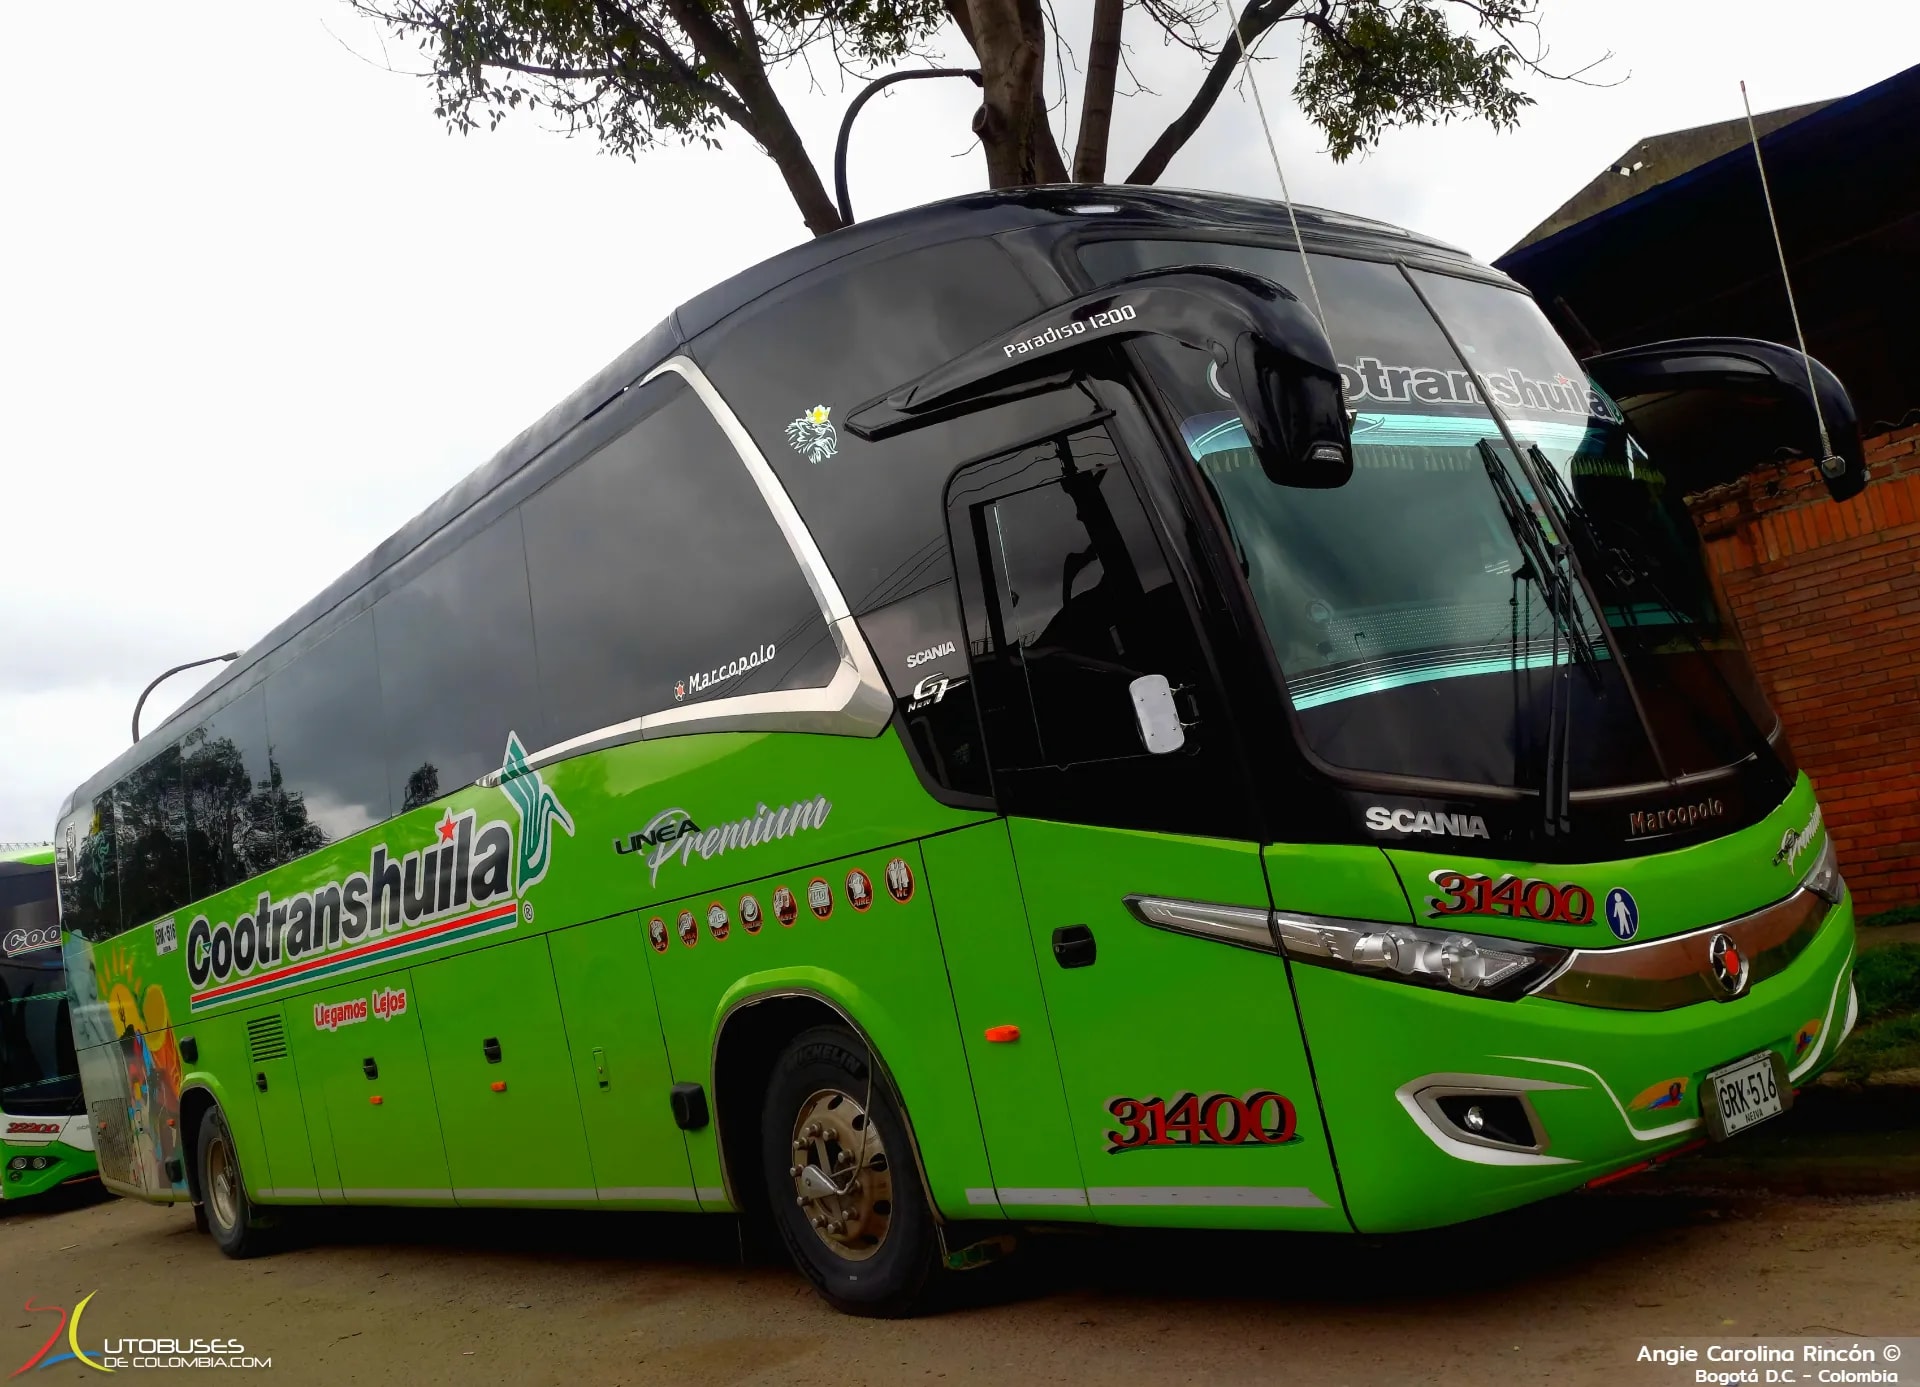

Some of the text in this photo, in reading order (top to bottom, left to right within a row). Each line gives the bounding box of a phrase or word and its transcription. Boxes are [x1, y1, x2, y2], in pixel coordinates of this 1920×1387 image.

[1003, 304, 1137, 358] Paradiso 1200
[1207, 356, 1616, 422] otranshuila
[688, 643, 776, 695] Marcopolo
[906, 640, 956, 668] SCANIA
[615, 794, 833, 888] LINEA Premium
[1365, 806, 1490, 840] SCANIA
[1630, 798, 1724, 835] Marcopolo
[187, 808, 512, 988] Cootranshuila
[1425, 868, 1598, 926] 31400
[372, 987, 407, 1021] Lejos
[1103, 1087, 1303, 1155] 31400
[1745, 1108, 1764, 1123] NEIVA
